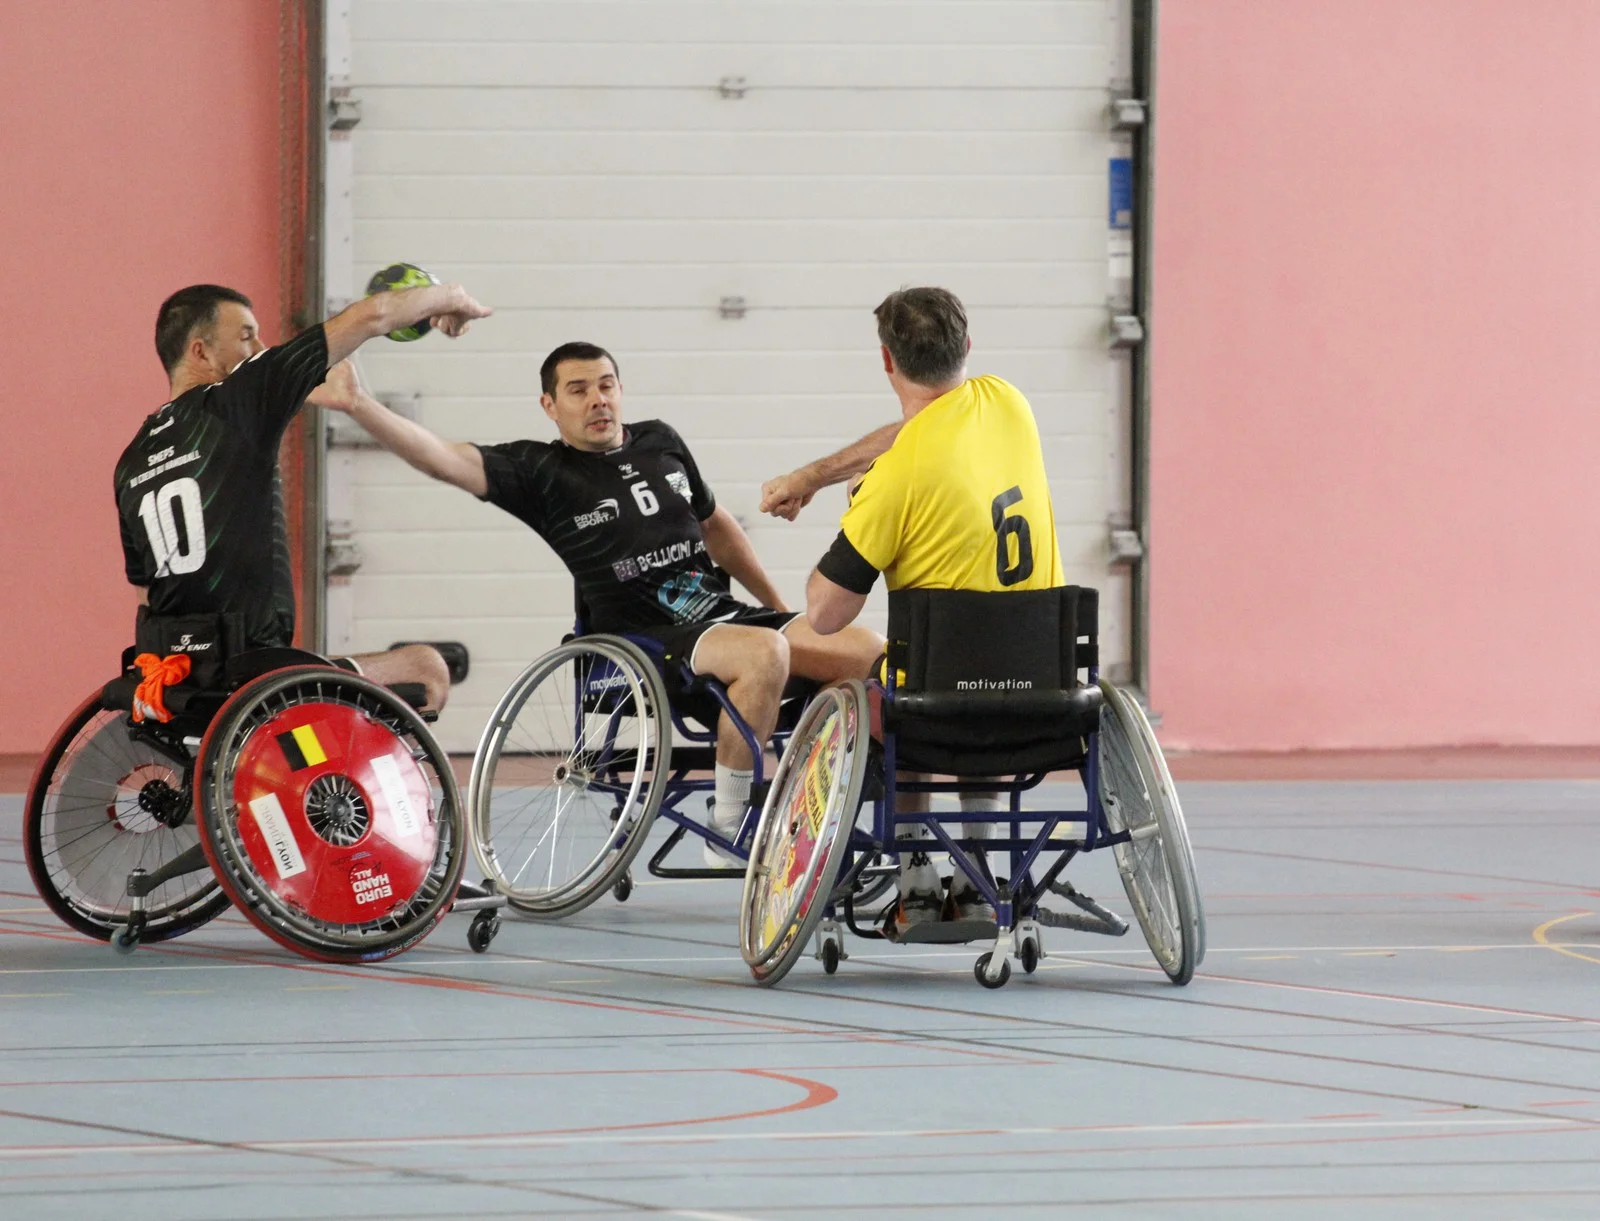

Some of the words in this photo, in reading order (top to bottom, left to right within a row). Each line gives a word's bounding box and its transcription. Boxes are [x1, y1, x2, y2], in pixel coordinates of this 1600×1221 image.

[630, 480, 660, 516] 6
[574, 510, 601, 524] PAYS
[577, 514, 610, 530] SPORT
[138, 477, 207, 579] 10
[991, 485, 1034, 587] 6
[185, 640, 212, 651] END
[590, 674, 629, 692] motivatio
[956, 678, 1033, 691] motivation
[352, 873, 389, 892] HAND
[356, 886, 392, 905] EURO
